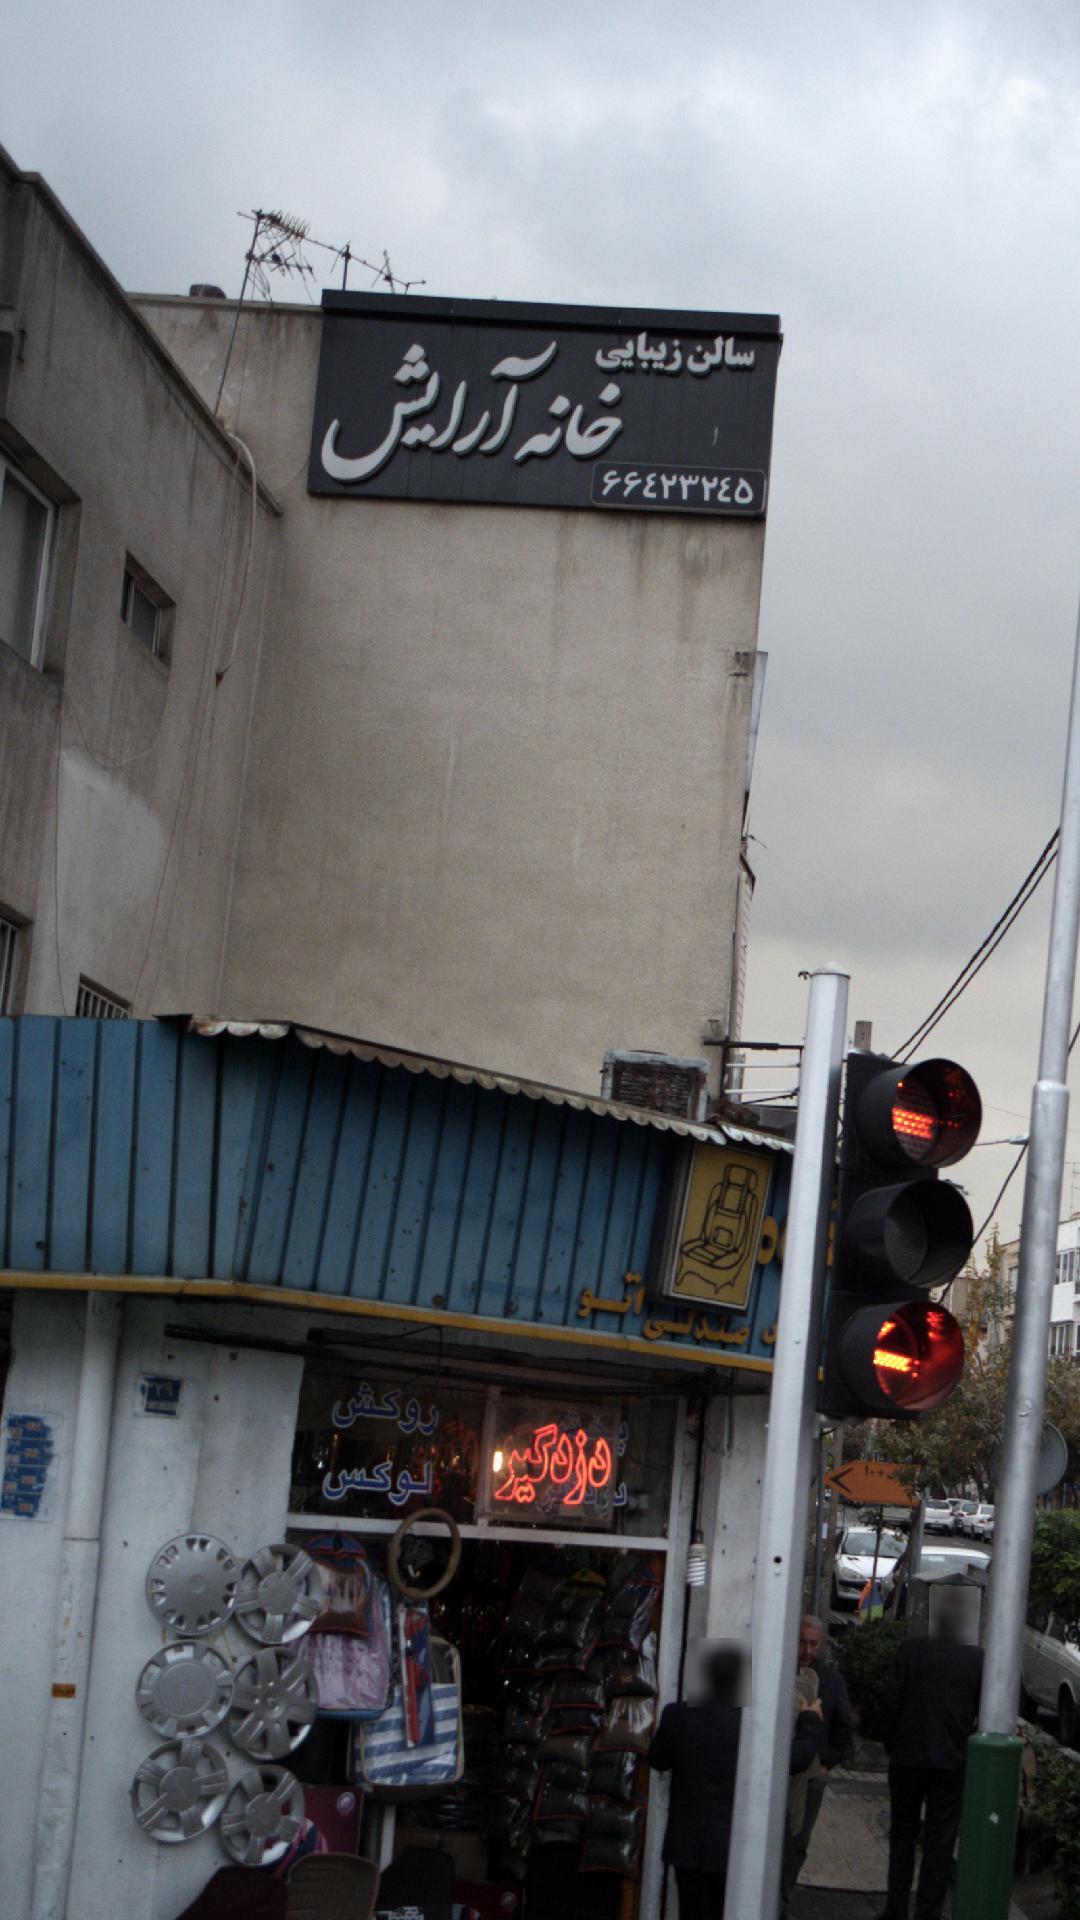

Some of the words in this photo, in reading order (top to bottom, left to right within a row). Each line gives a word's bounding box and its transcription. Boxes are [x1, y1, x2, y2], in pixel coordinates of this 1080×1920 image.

[594, 330, 682, 372] زیبایی
[686, 335, 756, 375] سالن
[321, 341, 557, 484] آرایش
[513, 382, 623, 464] خانه
[331, 1381, 440, 1435] روکش
[322, 1461, 432, 1507] لوکس
